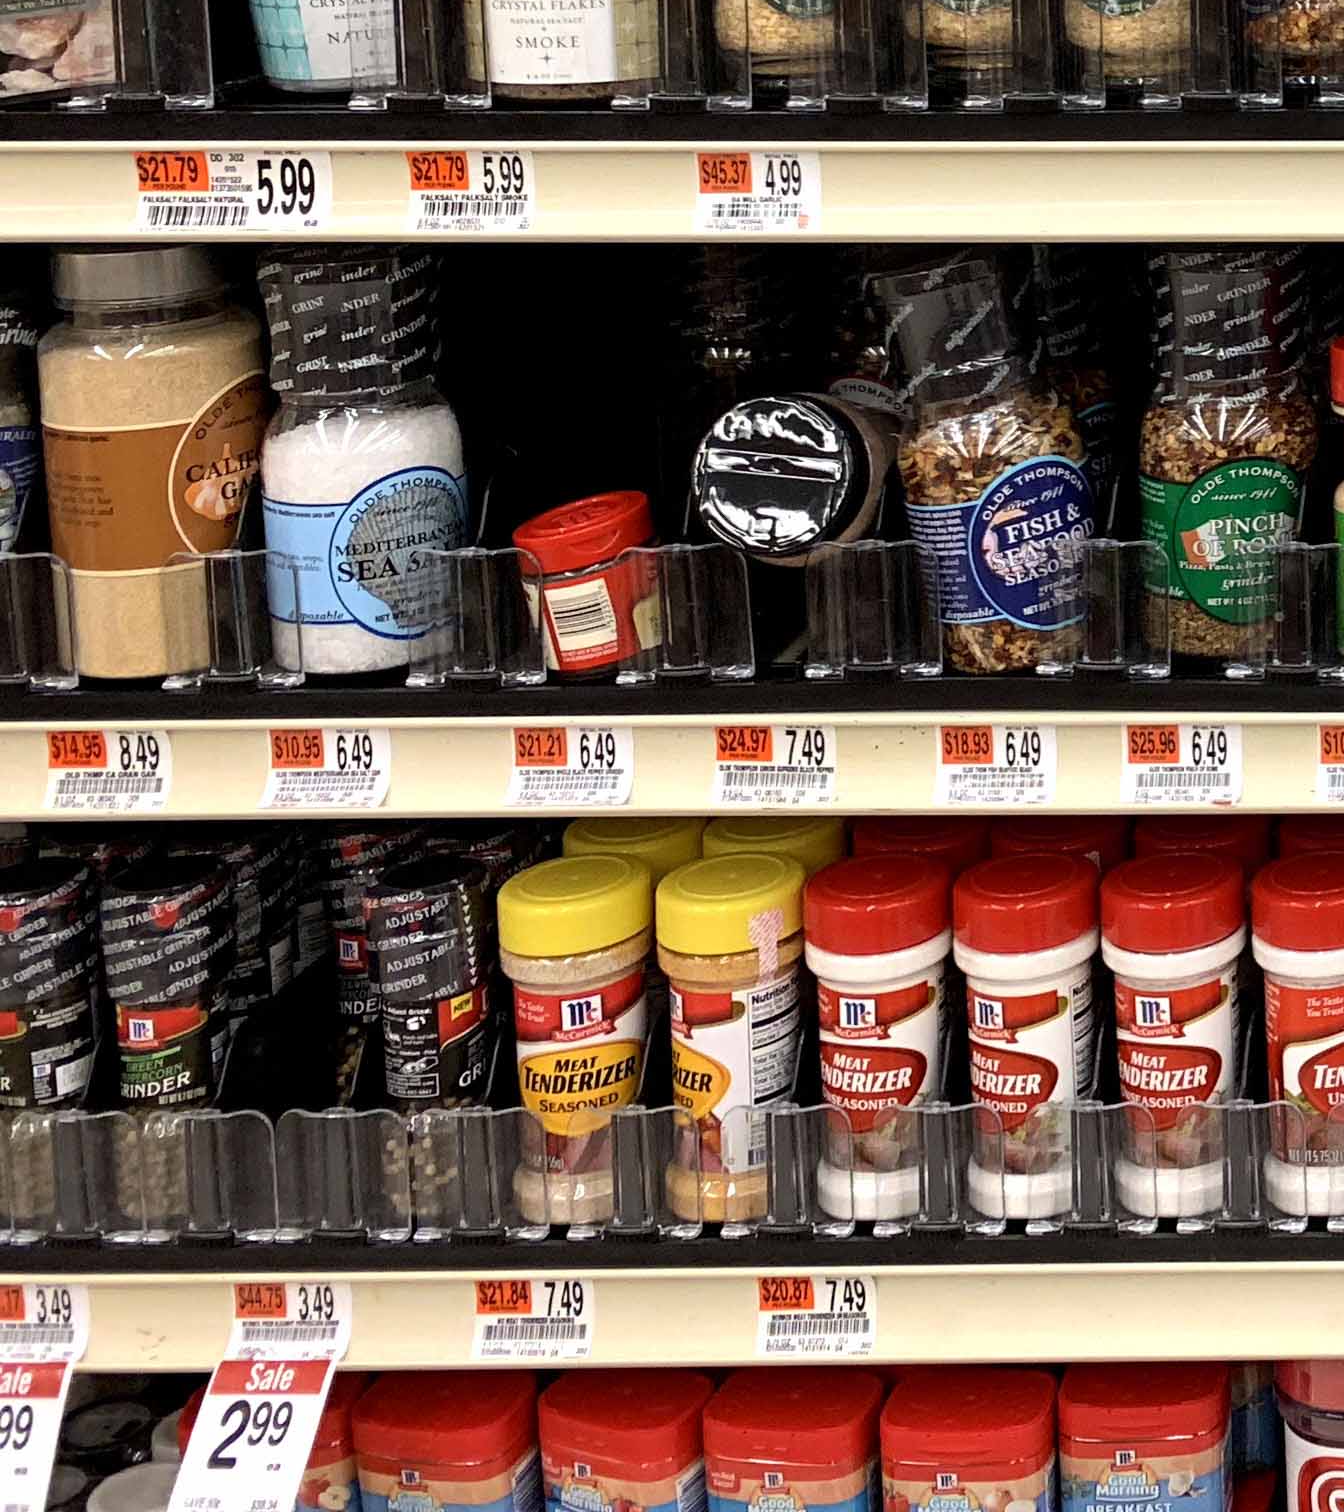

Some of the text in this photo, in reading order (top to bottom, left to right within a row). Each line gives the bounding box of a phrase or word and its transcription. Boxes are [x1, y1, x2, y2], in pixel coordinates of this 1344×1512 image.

[492, 0, 543, 10] CRYSTAL
[516, 35, 581, 48] SMOKE
[136, 156, 315, 215] $21.79 5.99
[1004, 503, 1080, 544] FISH &
[338, 557, 400, 582] SEA
[51, 736, 160, 770] $14.95 8.49
[524, 1058, 637, 1092] TENDERIZER
[554, 1057, 598, 1076] MEAT
[479, 1282, 584, 1316] $21.84 7.49
[245, 1363, 294, 1390] Sale
